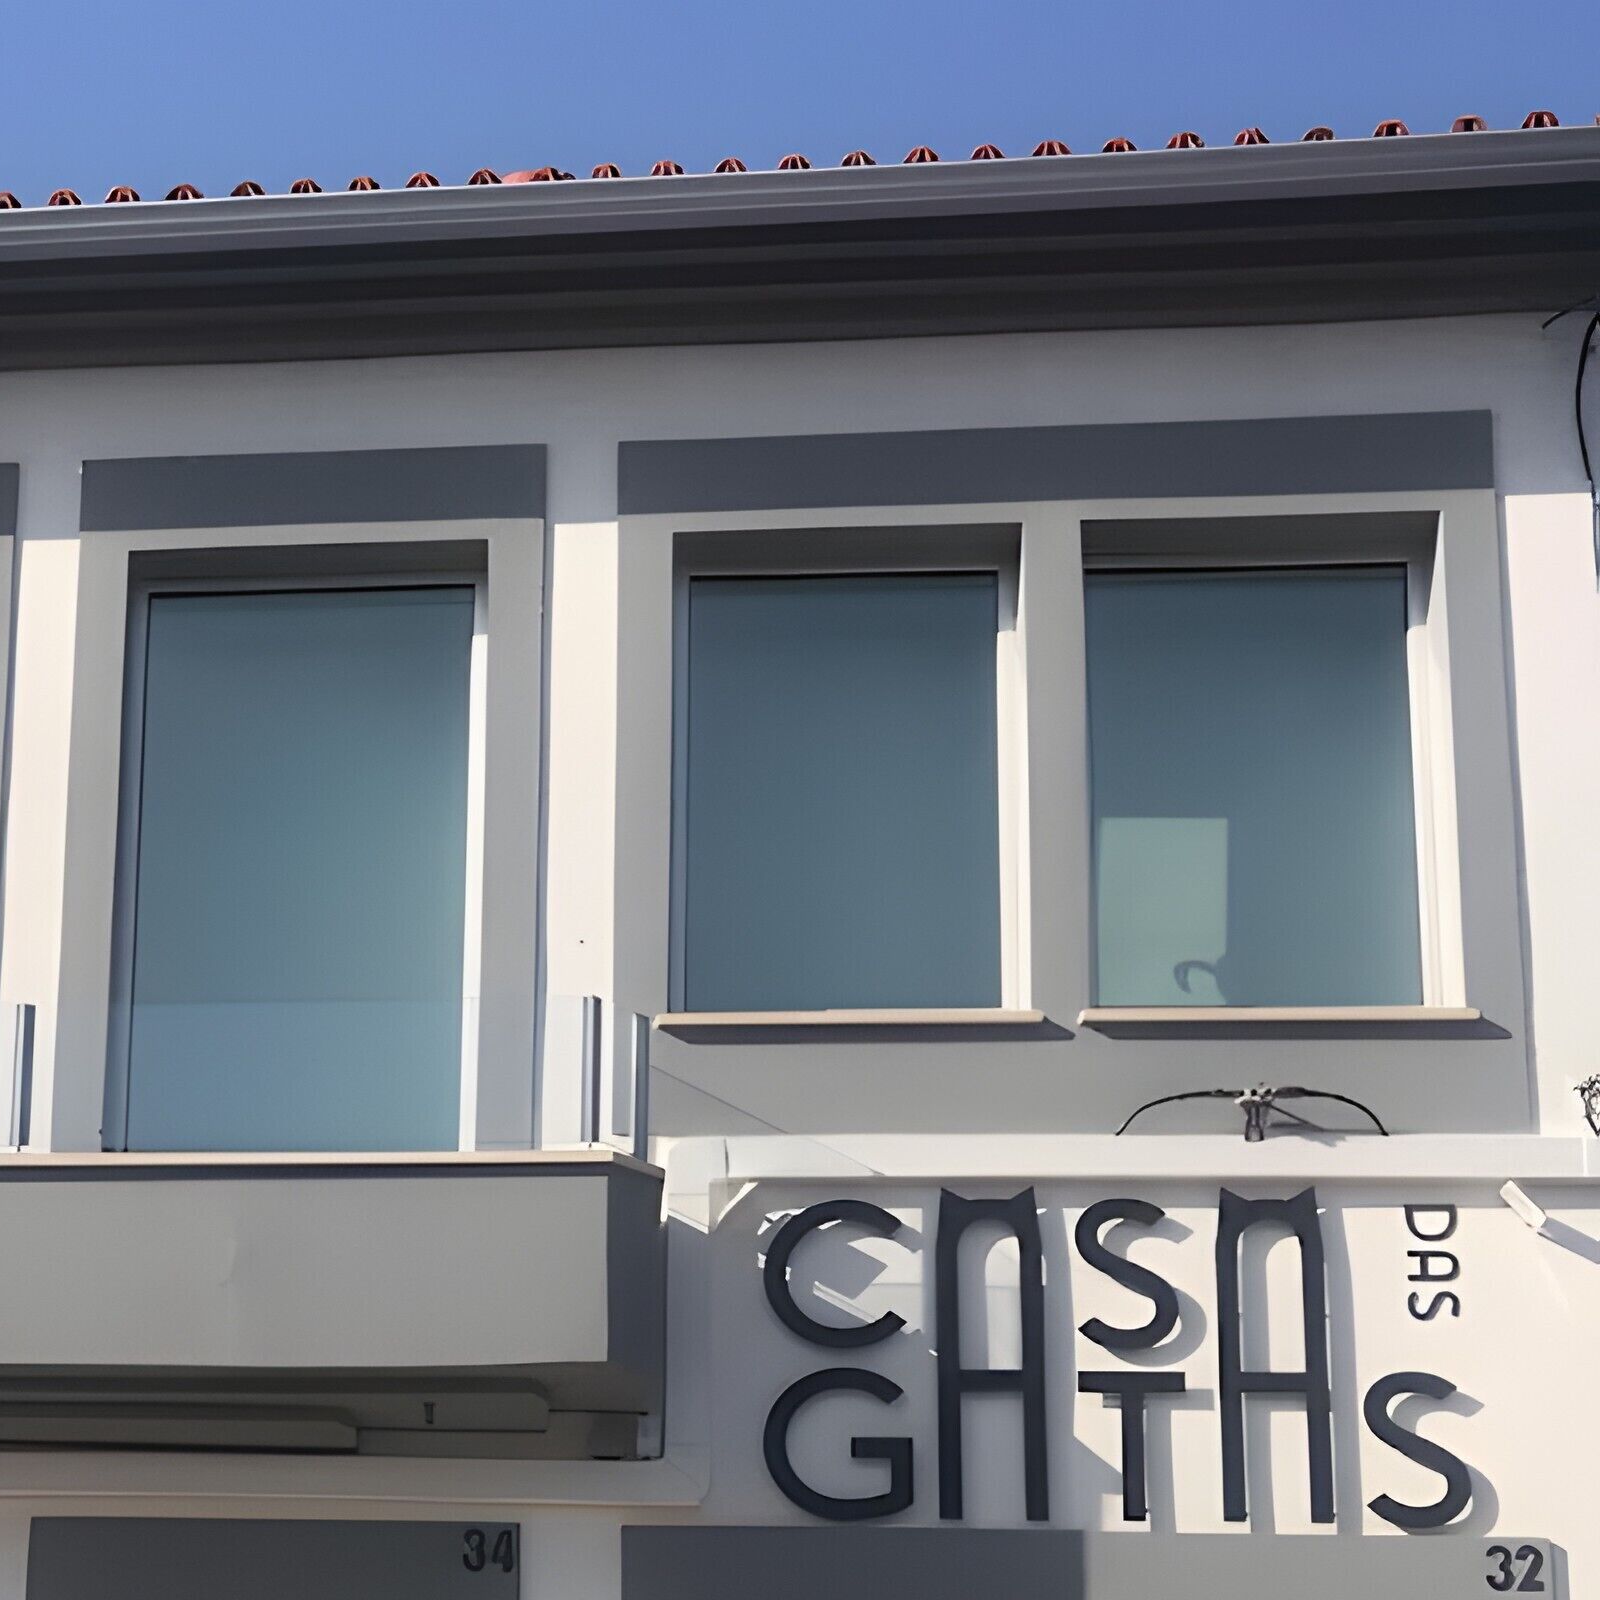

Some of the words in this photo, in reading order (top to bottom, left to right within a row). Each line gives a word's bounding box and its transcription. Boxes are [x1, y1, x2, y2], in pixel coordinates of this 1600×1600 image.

[763, 1186, 1332, 1385] CASA
[1404, 1203, 1461, 1322] DAS
[763, 1352, 1473, 1530] GATAS
[462, 1529, 514, 1573] 34
[1485, 1545, 1545, 1592] 32
